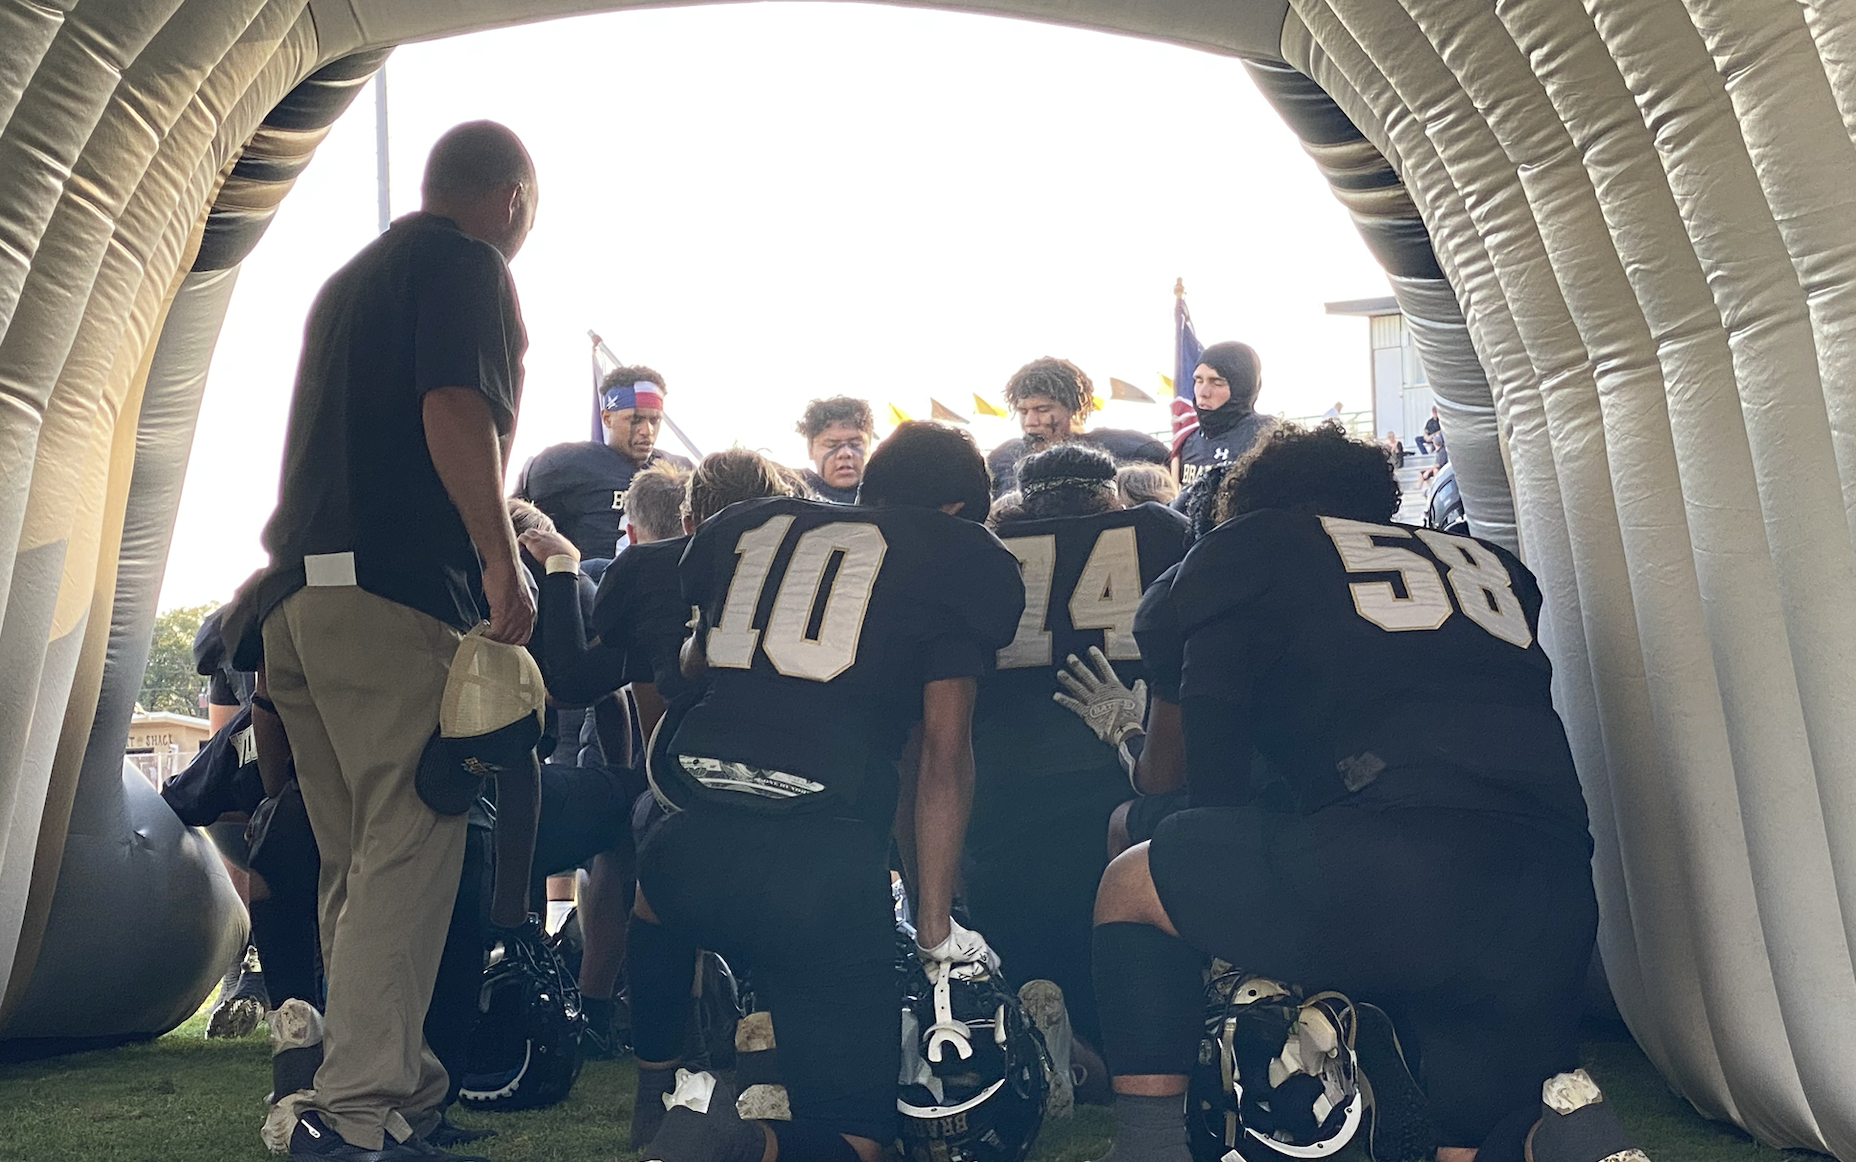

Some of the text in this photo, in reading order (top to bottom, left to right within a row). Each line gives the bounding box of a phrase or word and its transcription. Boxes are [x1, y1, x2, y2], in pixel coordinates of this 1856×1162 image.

[706, 514, 888, 683] 10
[1316, 515, 1532, 649] 58
[146, 733, 173, 747] SHACK
